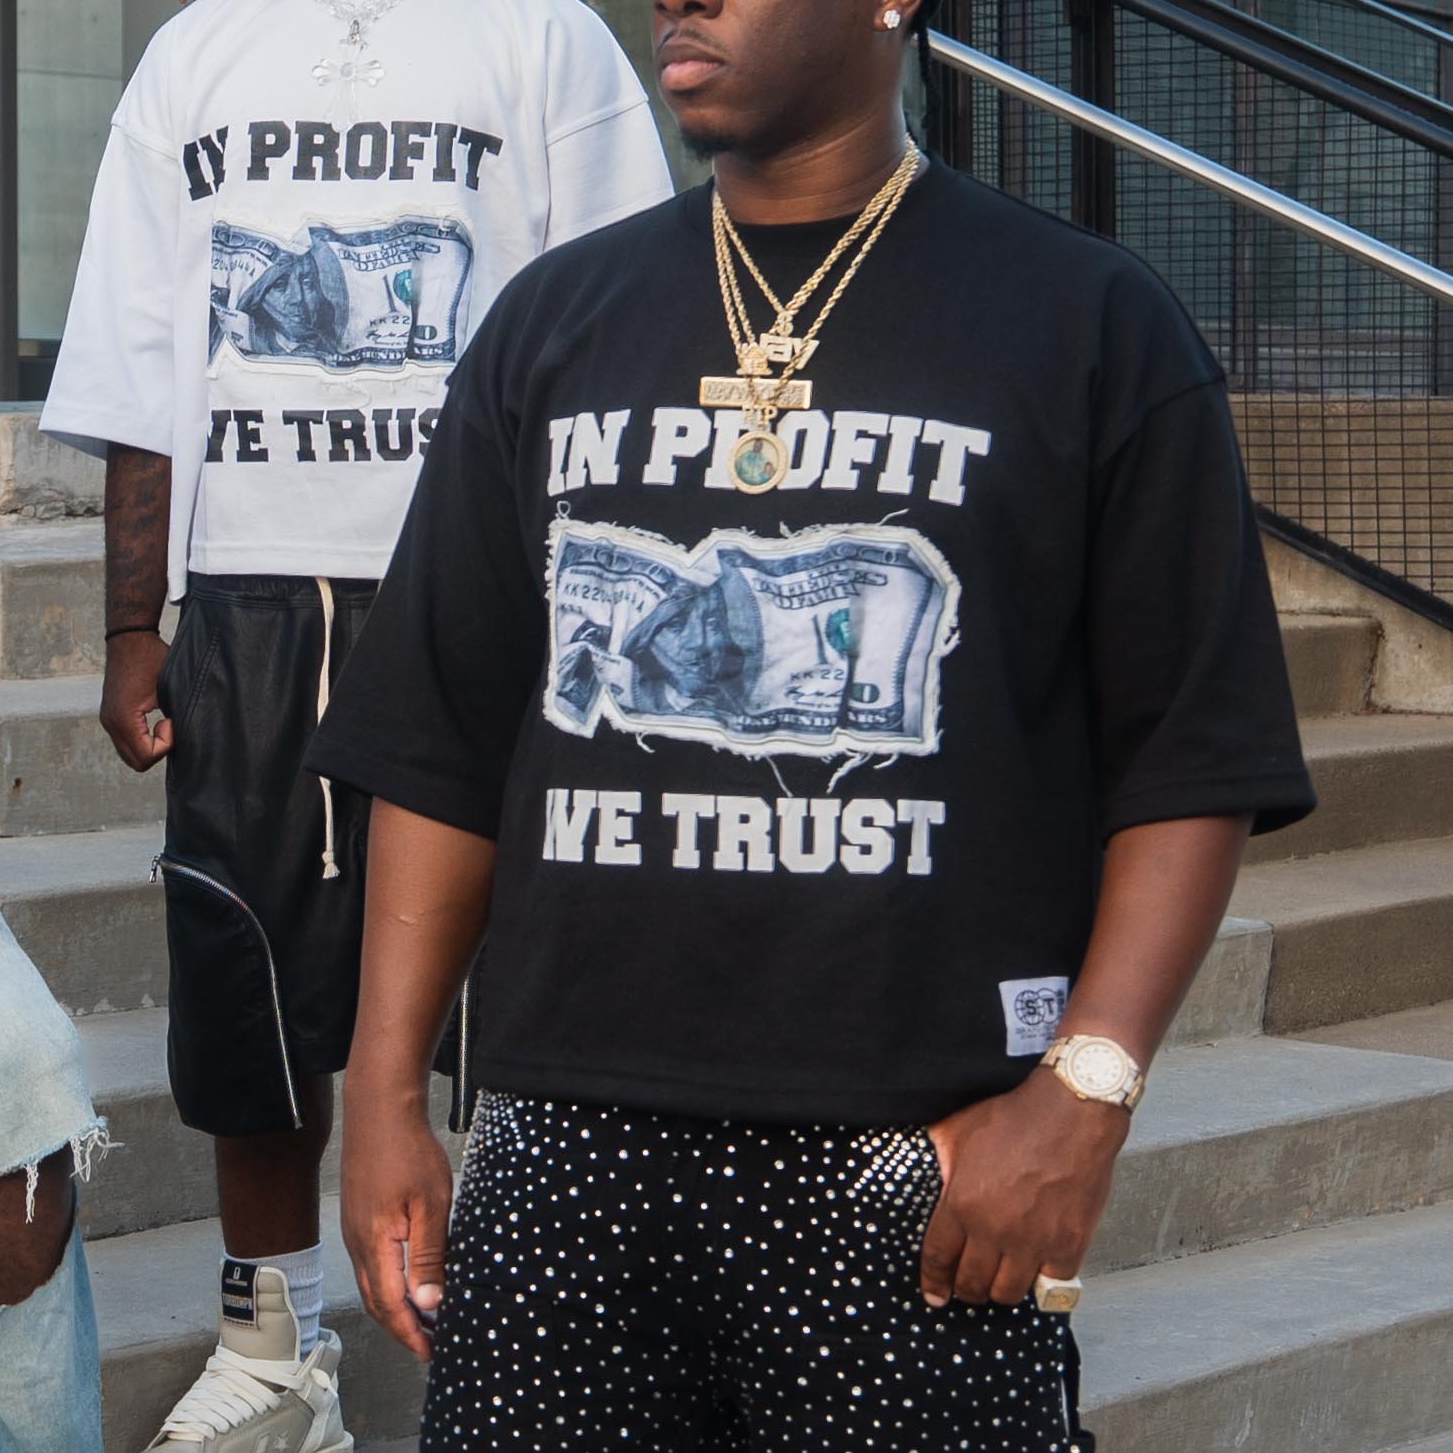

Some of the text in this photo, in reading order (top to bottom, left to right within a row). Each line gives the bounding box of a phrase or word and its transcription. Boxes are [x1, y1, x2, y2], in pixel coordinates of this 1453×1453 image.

[246, 120, 504, 191] PROFIT
[547, 409, 632, 498] IN
[542, 787, 947, 875] WE TRUST
